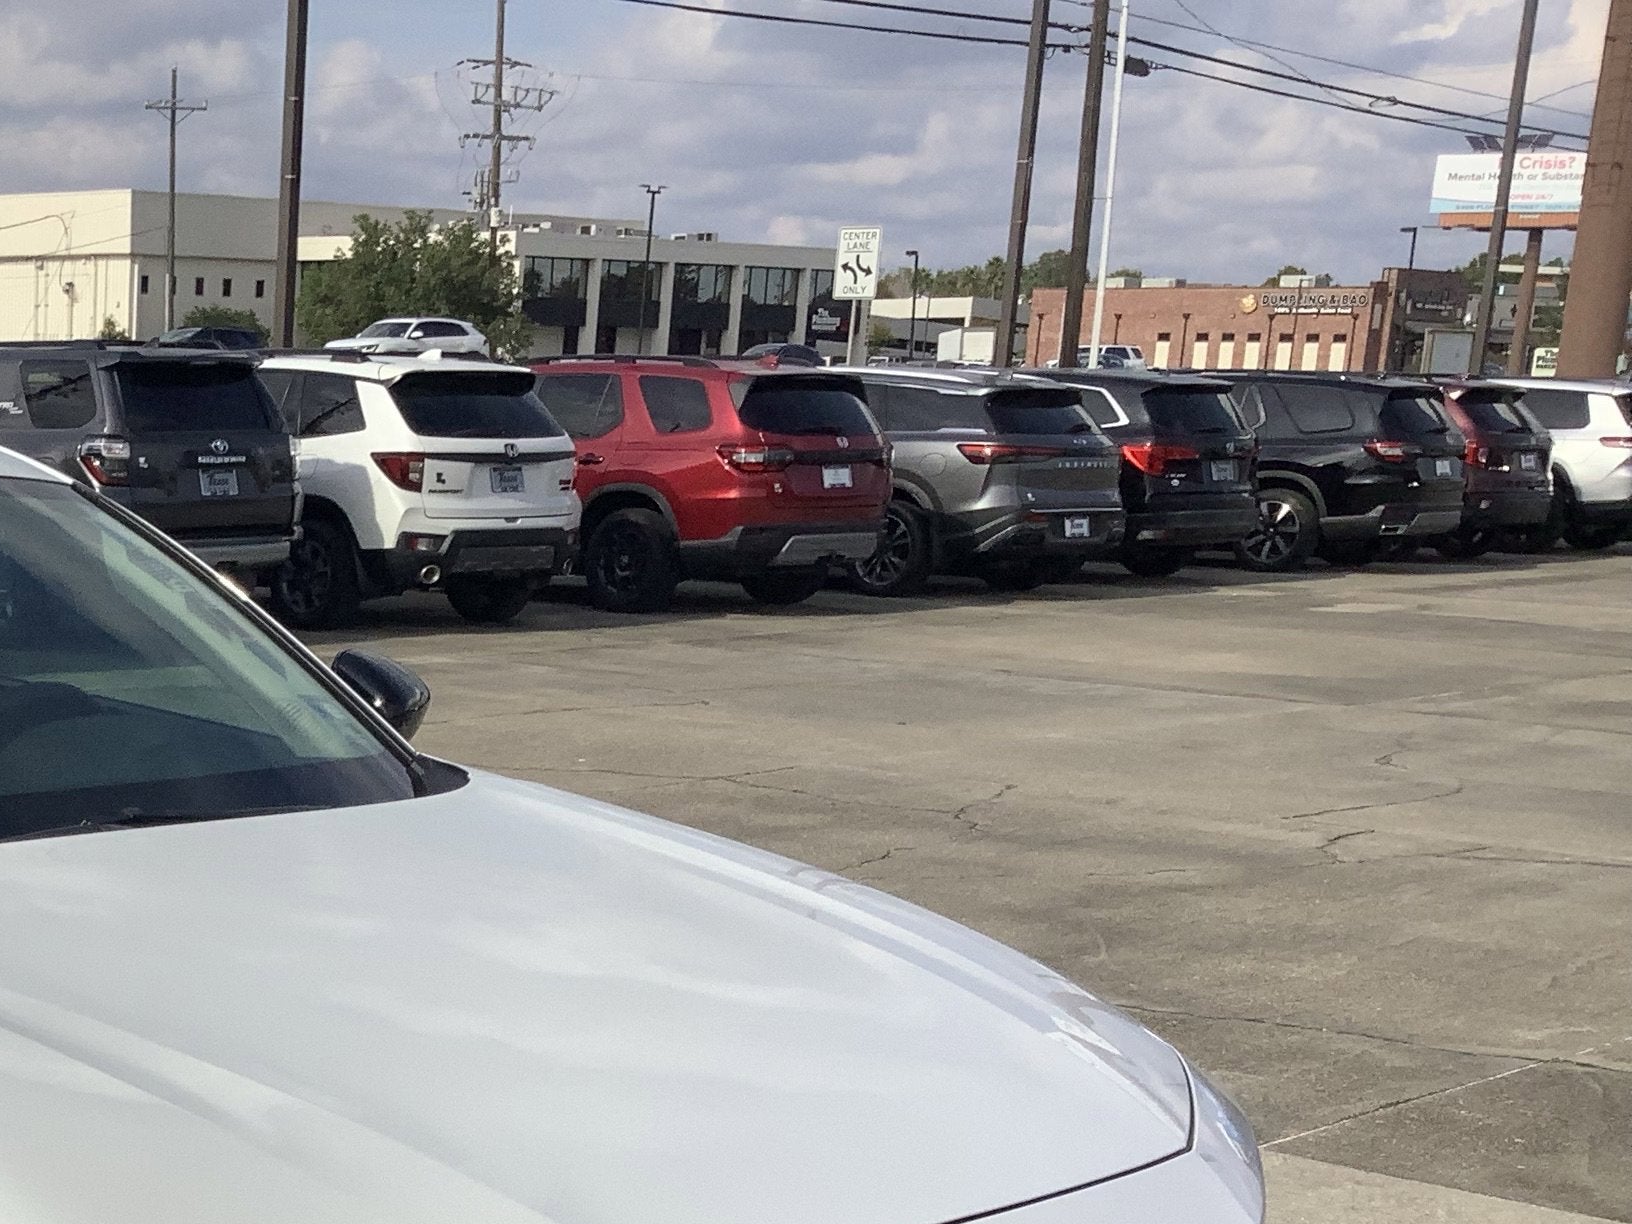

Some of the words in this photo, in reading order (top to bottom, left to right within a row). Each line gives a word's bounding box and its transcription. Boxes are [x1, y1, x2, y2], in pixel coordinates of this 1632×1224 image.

[1519, 156, 1576, 170] Crisis?
[1447, 172, 1485, 182] Mental
[1488, 172, 1524, 182] Heth
[1527, 173, 1539, 181] or
[842, 231, 878, 241] CENTER
[847, 241, 871, 251] LANE
[842, 285, 867, 295] ONLY
[1262, 294, 1326, 305] DUMPING
[1328, 294, 1337, 305] &
[1342, 294, 1368, 305] BAO
